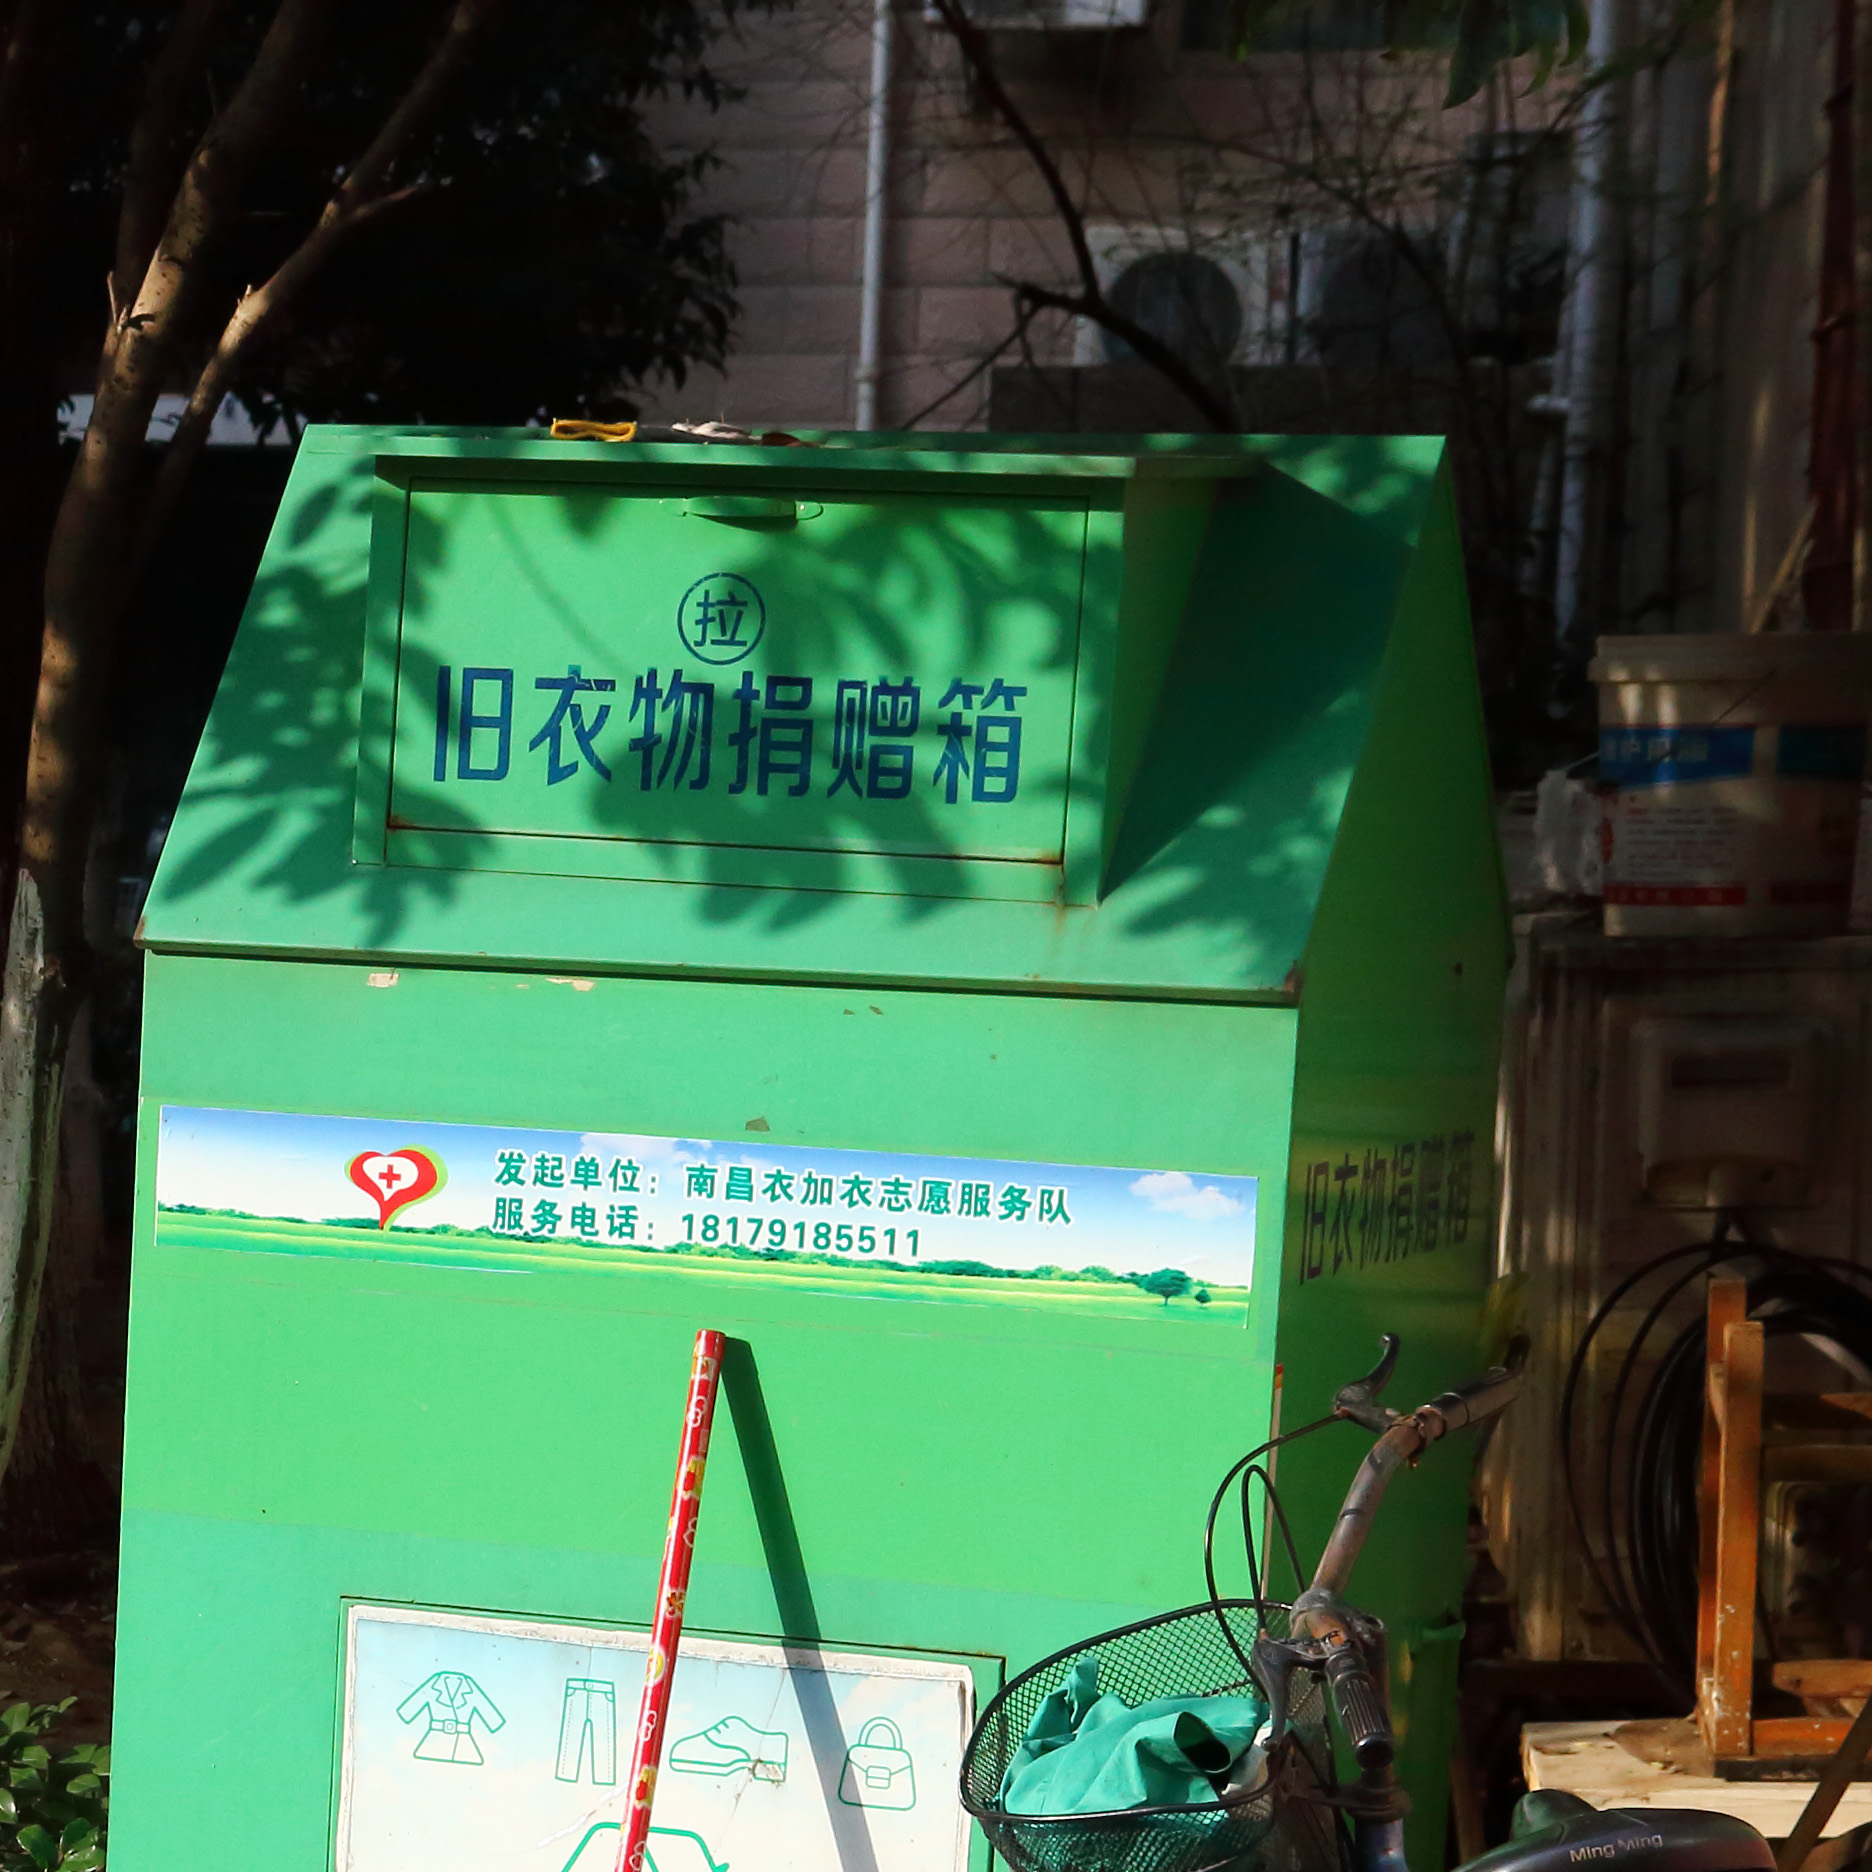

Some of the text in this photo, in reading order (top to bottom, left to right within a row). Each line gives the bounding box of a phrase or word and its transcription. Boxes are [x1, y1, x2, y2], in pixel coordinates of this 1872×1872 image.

[693, 588, 749, 648] 拉
[433, 663, 1028, 805] 旧衣物捐赠箱
